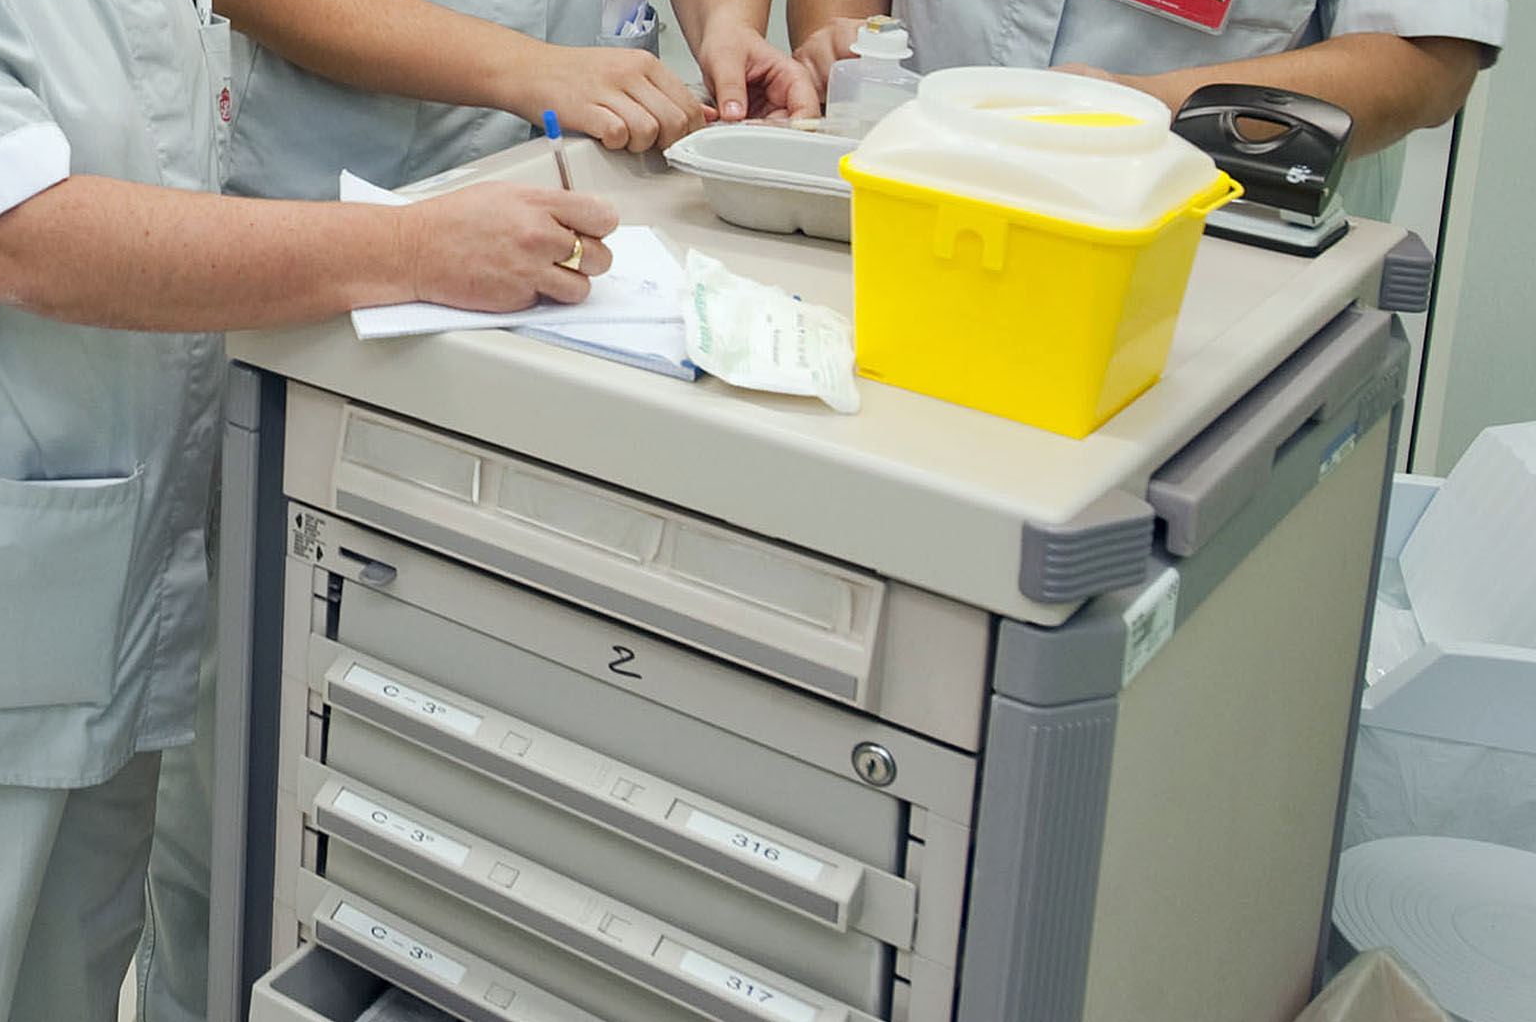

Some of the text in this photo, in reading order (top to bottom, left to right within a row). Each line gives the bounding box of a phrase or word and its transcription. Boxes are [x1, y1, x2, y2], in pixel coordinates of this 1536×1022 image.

[608, 644, 642, 680] 2
[382, 684, 400, 698] C
[371, 810, 389, 825] C
[730, 832, 781, 863] 316
[371, 924, 388, 939] C
[725, 976, 775, 1003] 317
